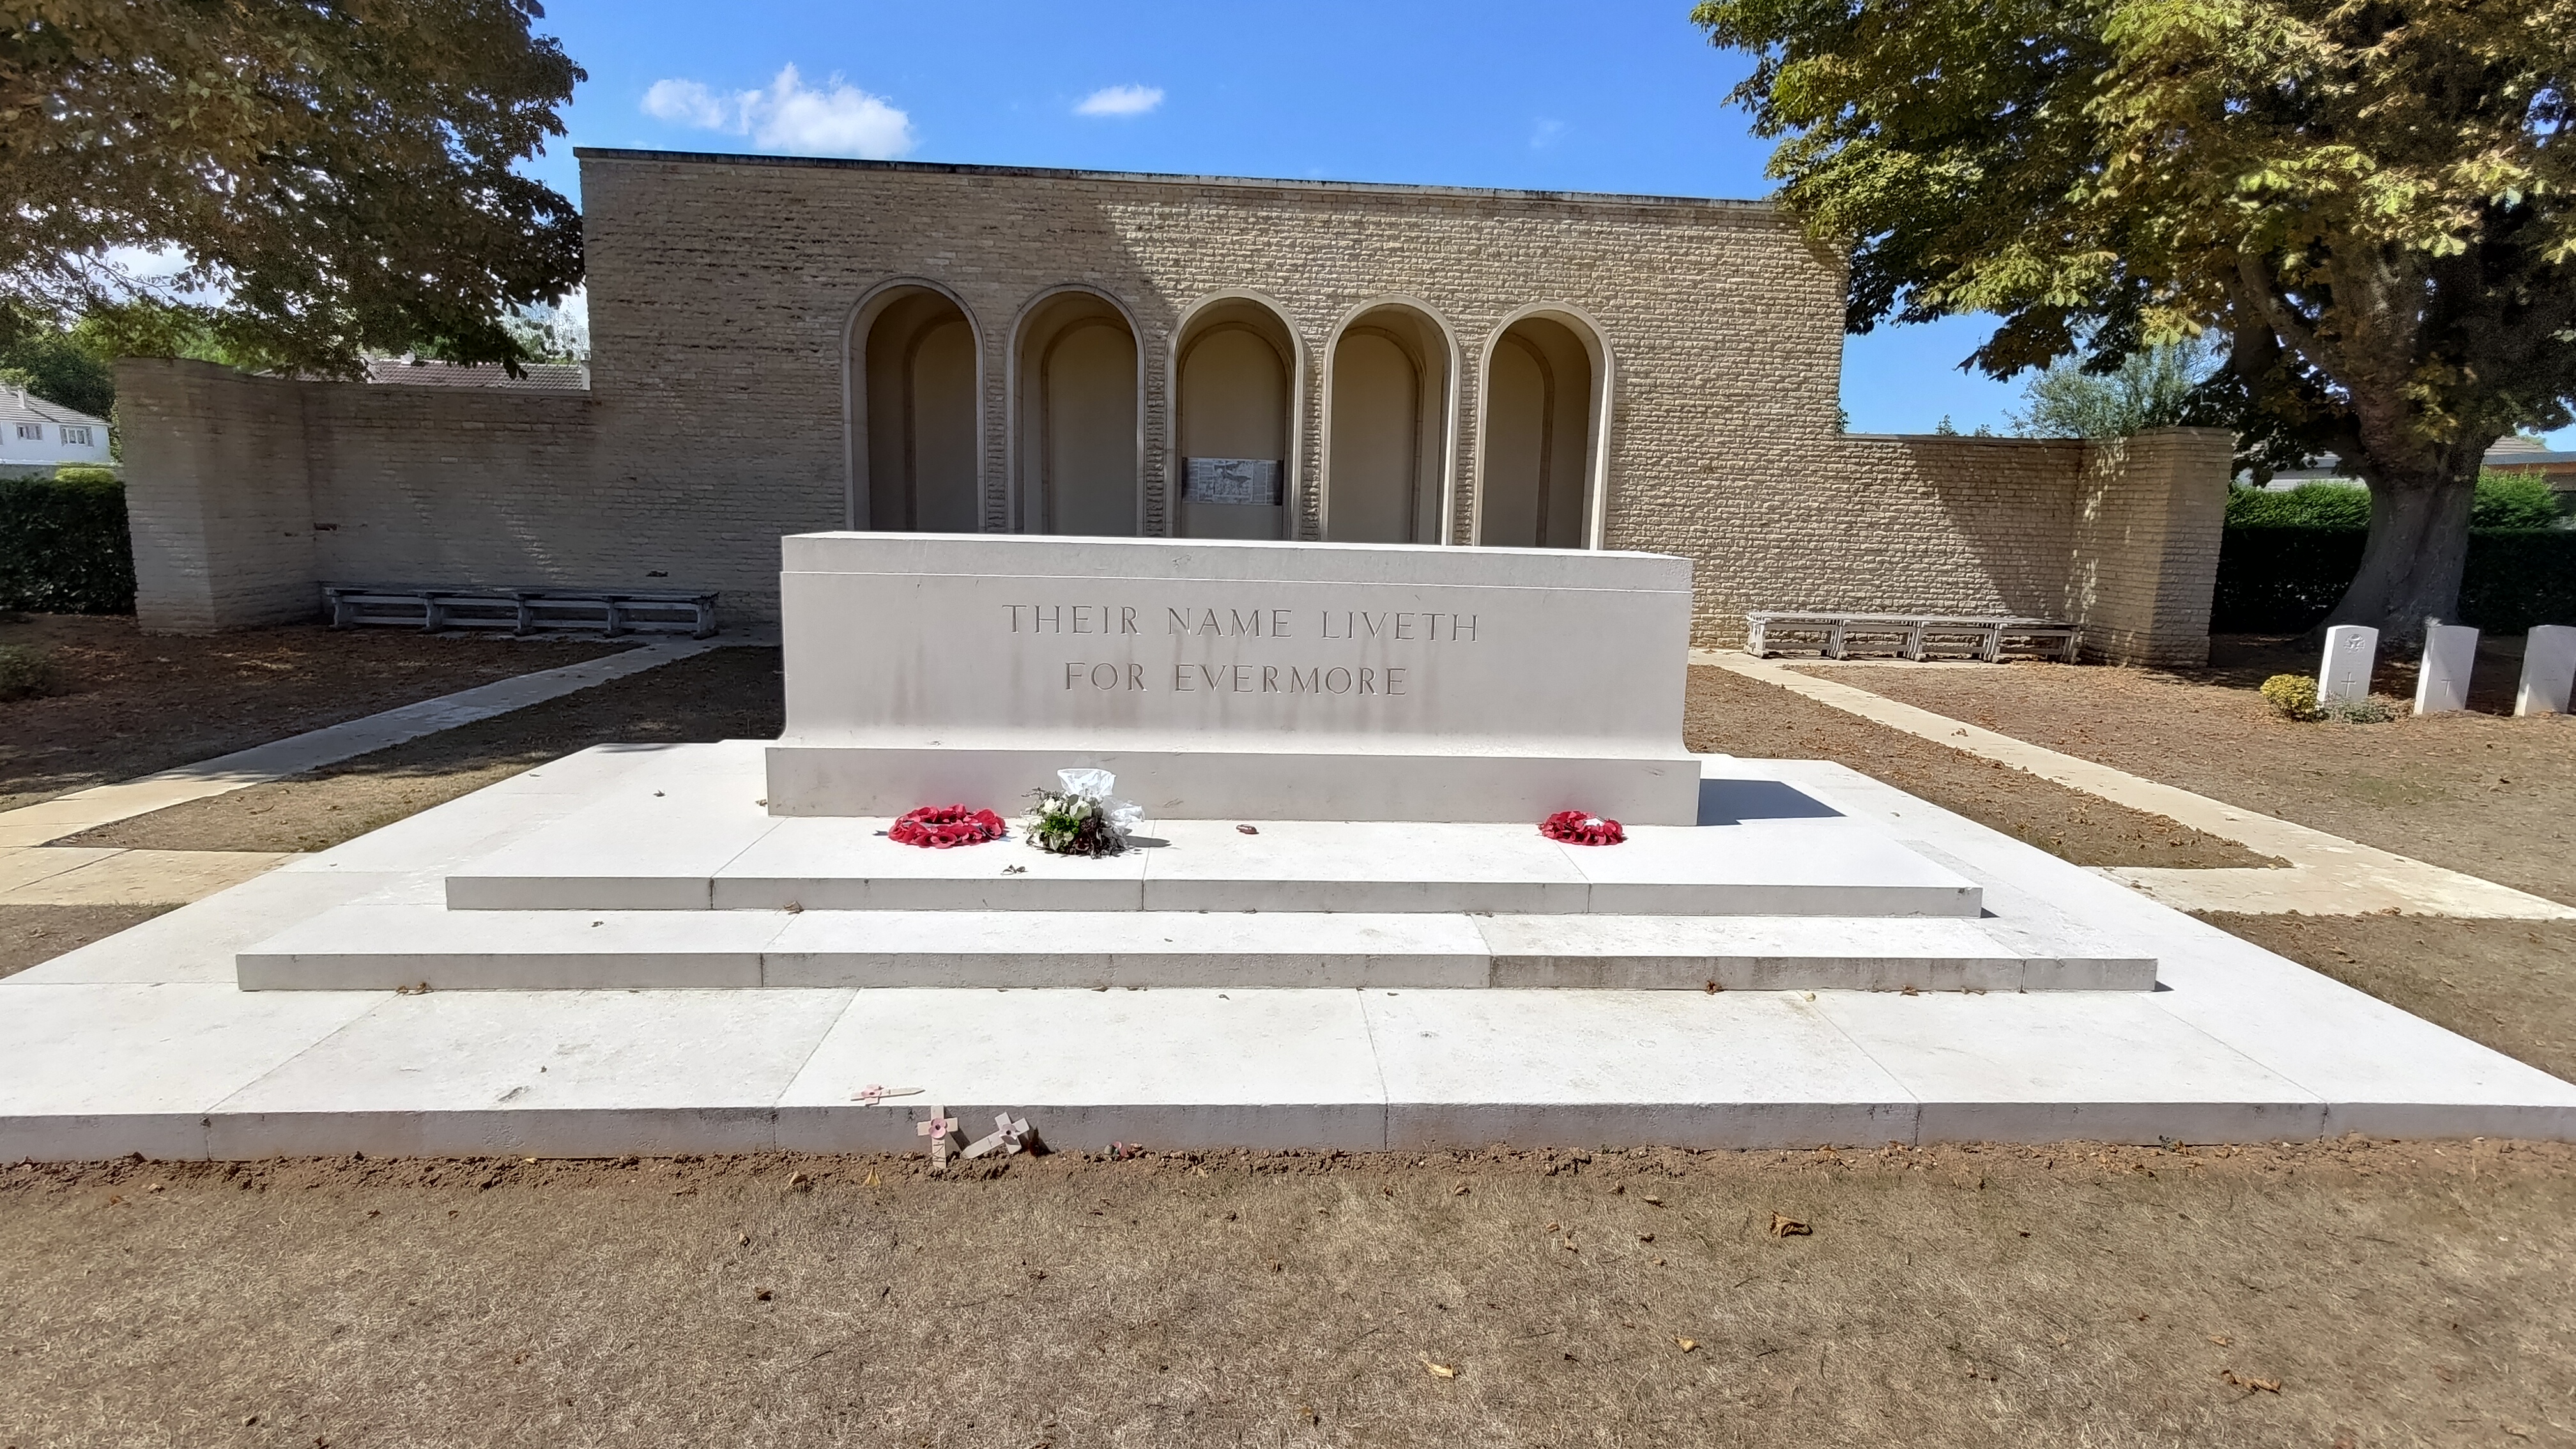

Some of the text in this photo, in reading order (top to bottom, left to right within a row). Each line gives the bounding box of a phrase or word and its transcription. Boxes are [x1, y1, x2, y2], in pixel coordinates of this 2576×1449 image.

[1001, 604, 1478, 642] THEIR NAME LIVETH
[1065, 662, 1407, 695] FOR EVERMORE
